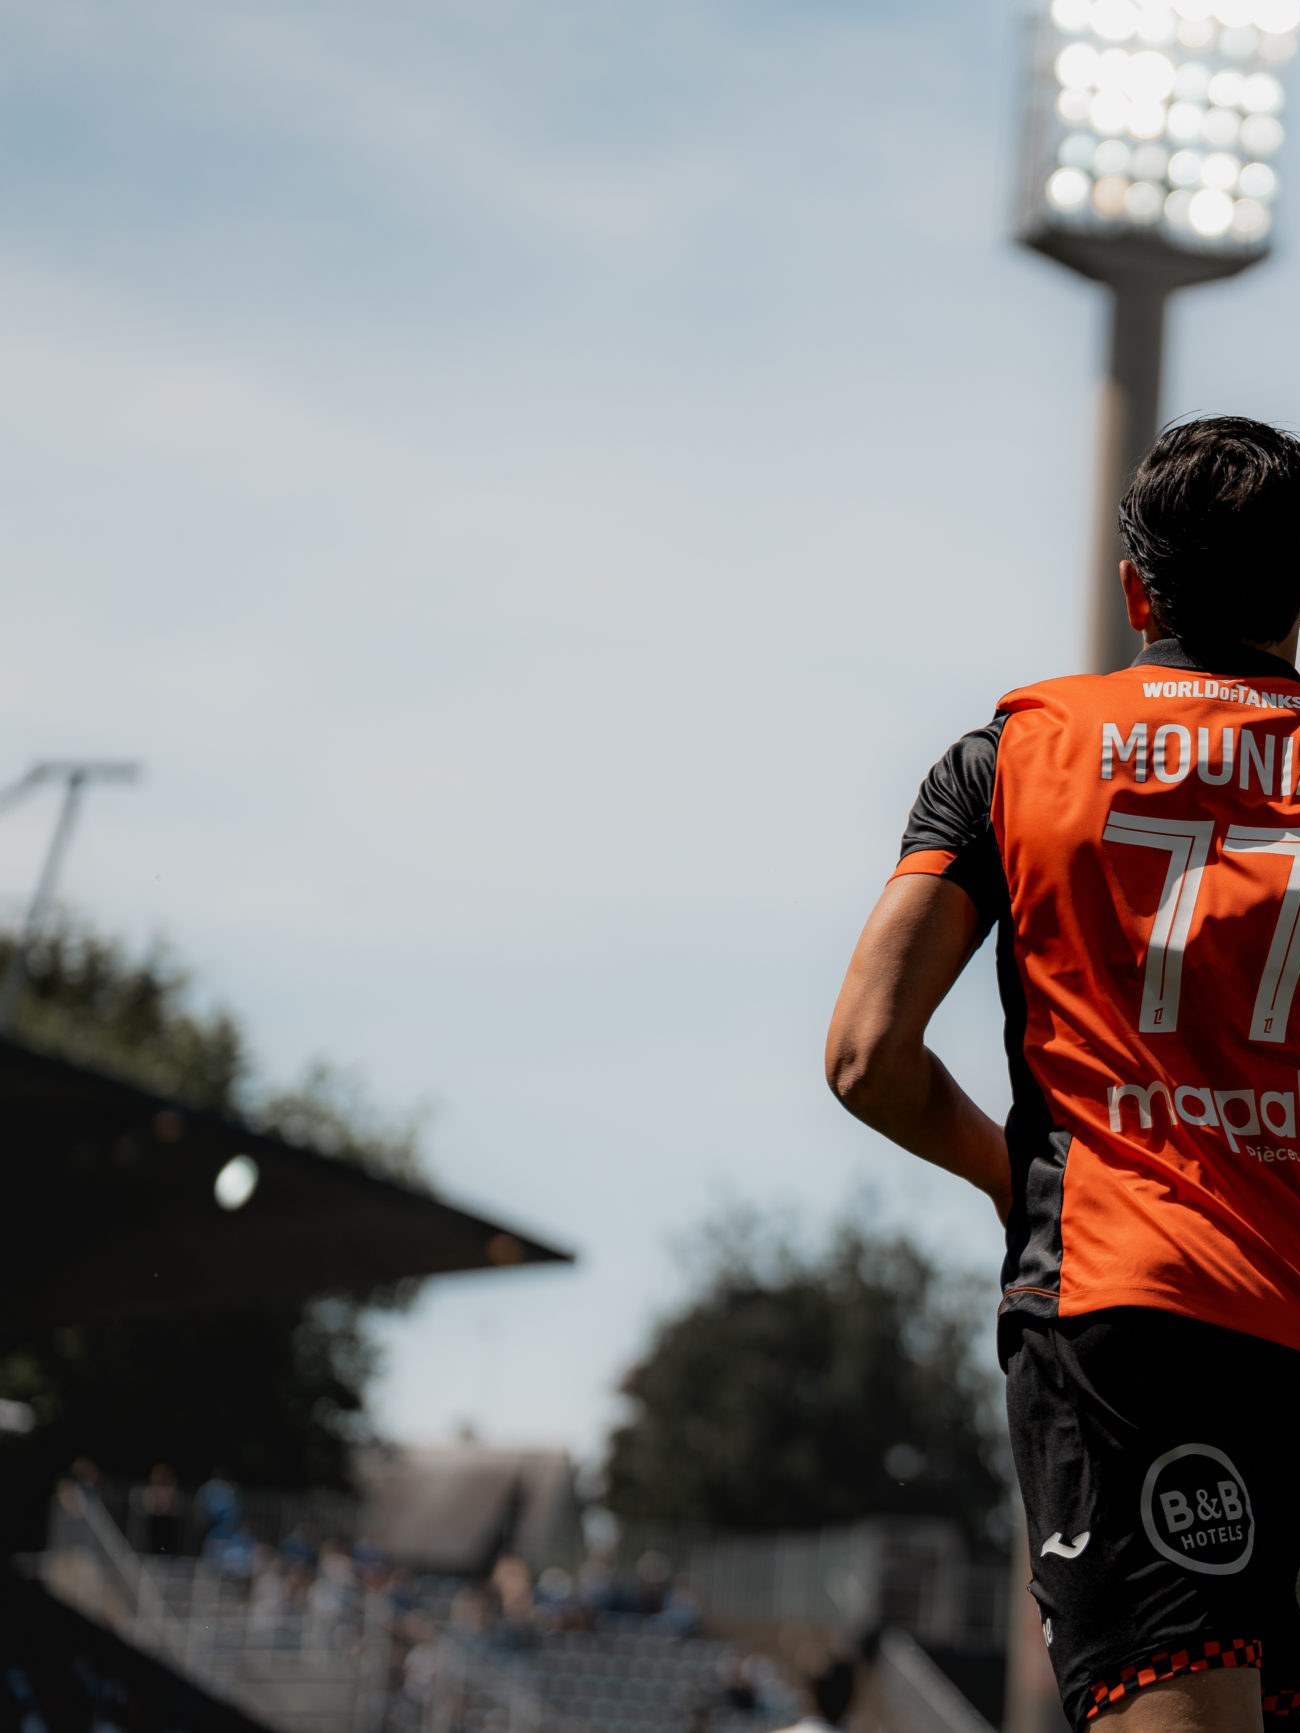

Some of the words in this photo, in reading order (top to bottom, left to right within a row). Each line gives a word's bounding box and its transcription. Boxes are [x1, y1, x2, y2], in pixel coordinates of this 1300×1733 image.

[1142, 680, 1219, 698] WORLD
[1219, 686, 1239, 702] OF
[1159, 1480, 1243, 1534] B&B
[1180, 1524, 1243, 1550] HOTELS
